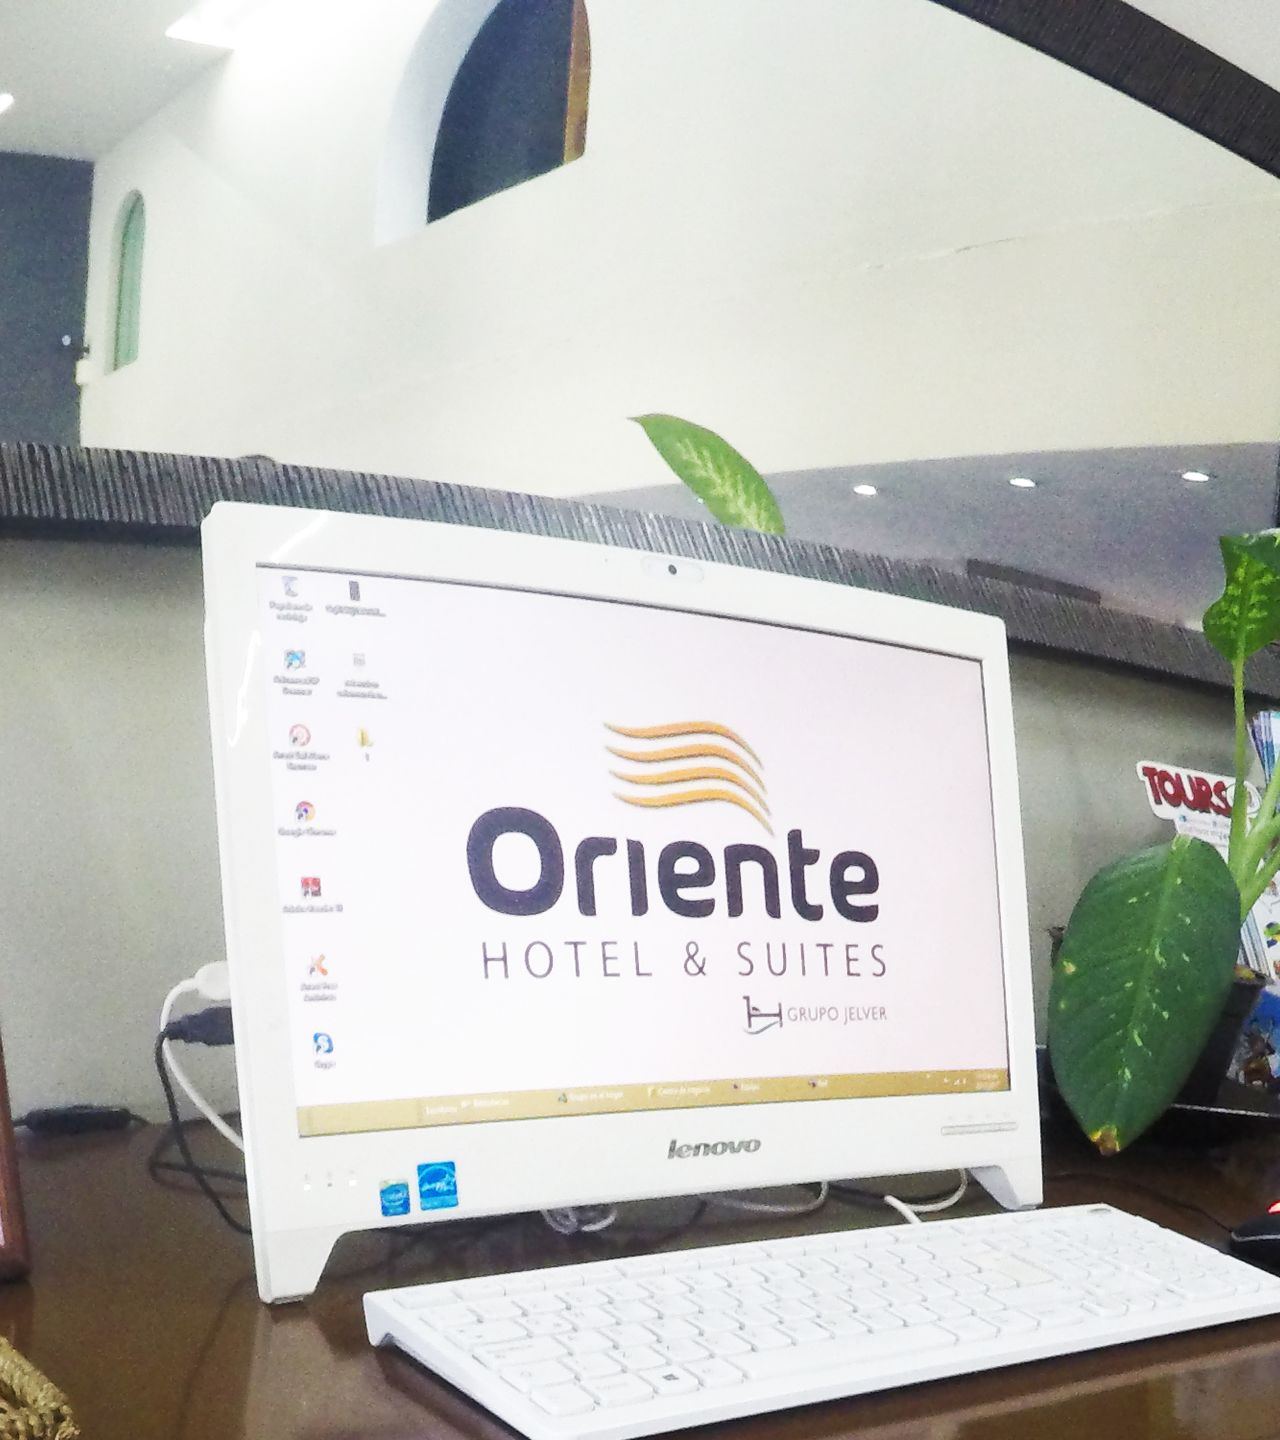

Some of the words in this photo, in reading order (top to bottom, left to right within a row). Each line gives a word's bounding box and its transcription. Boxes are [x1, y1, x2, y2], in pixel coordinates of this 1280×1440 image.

[1143, 766, 1232, 818] TOURS
[467, 807, 880, 923] Oriente
[481, 940, 652, 979] HOTEL
[683, 940, 707, 977] &
[737, 940, 887, 978] SUITES
[787, 1006, 839, 1023] GRUPO
[843, 1005, 888, 1025] JELVER
[667, 1138, 762, 1160] lenovo
